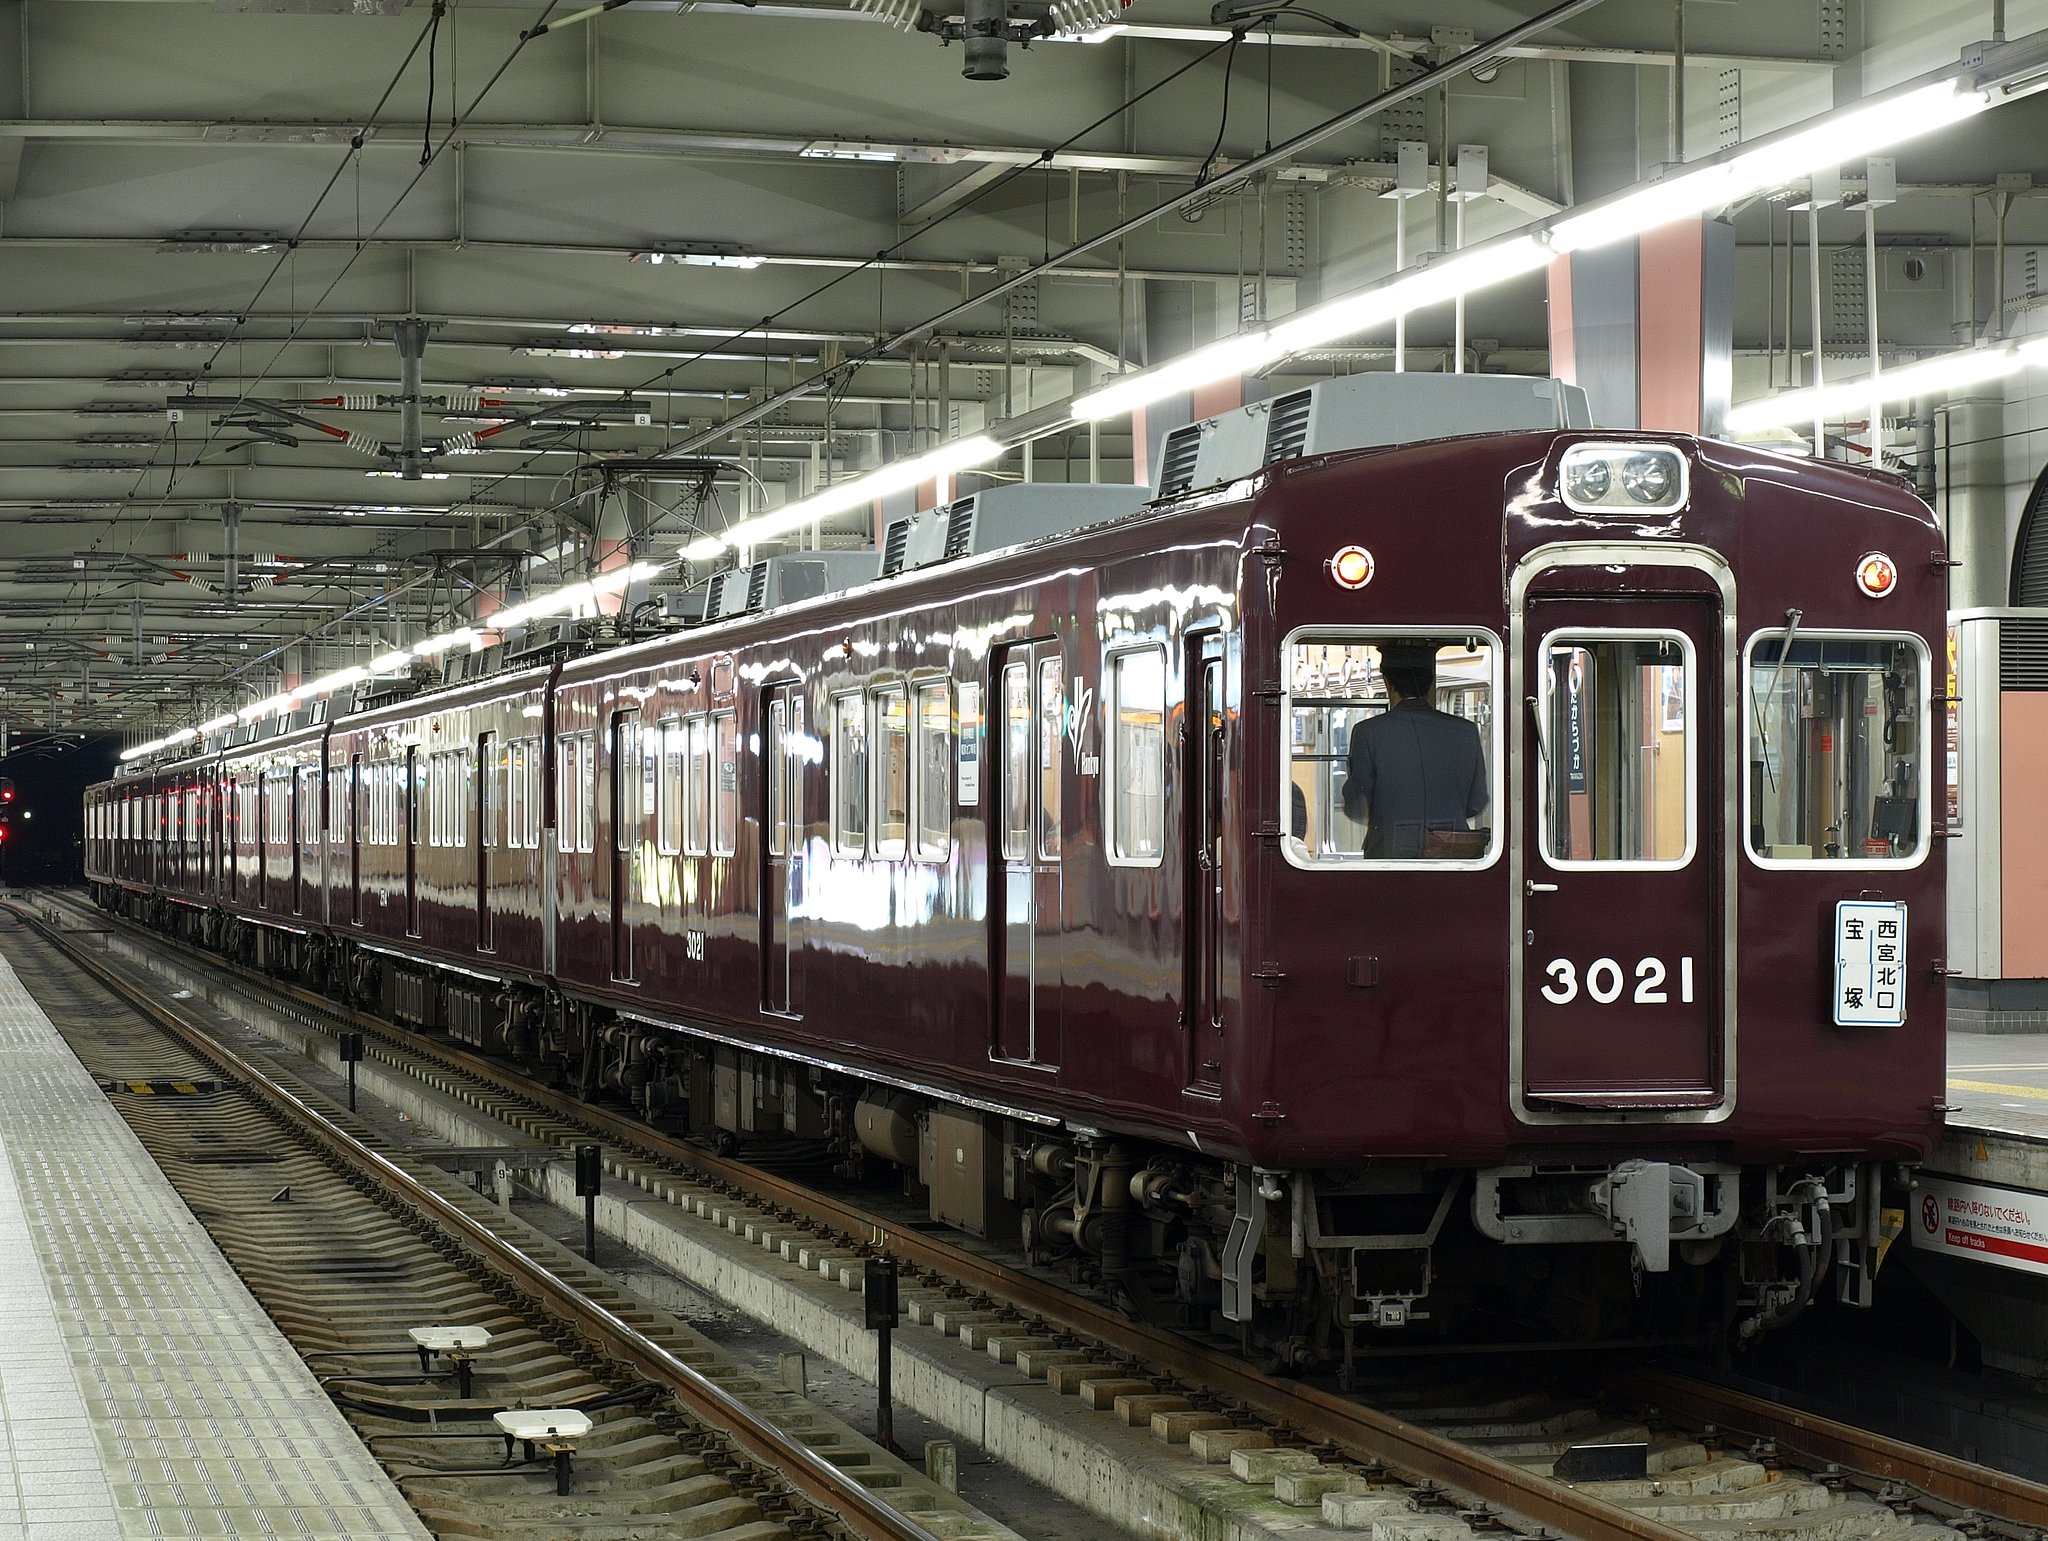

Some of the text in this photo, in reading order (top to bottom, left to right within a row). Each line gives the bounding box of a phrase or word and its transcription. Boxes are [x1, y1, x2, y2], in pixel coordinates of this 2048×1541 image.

[686, 931, 704, 961] 3021
[1844, 918, 1864, 1009] 宝塚
[1877, 920, 1898, 1009] 西宮北口
[1541, 956, 1694, 1005] 3021
[498, 1169, 505, 1179] 9
[1948, 1232, 1986, 1249] Keep off tracks
